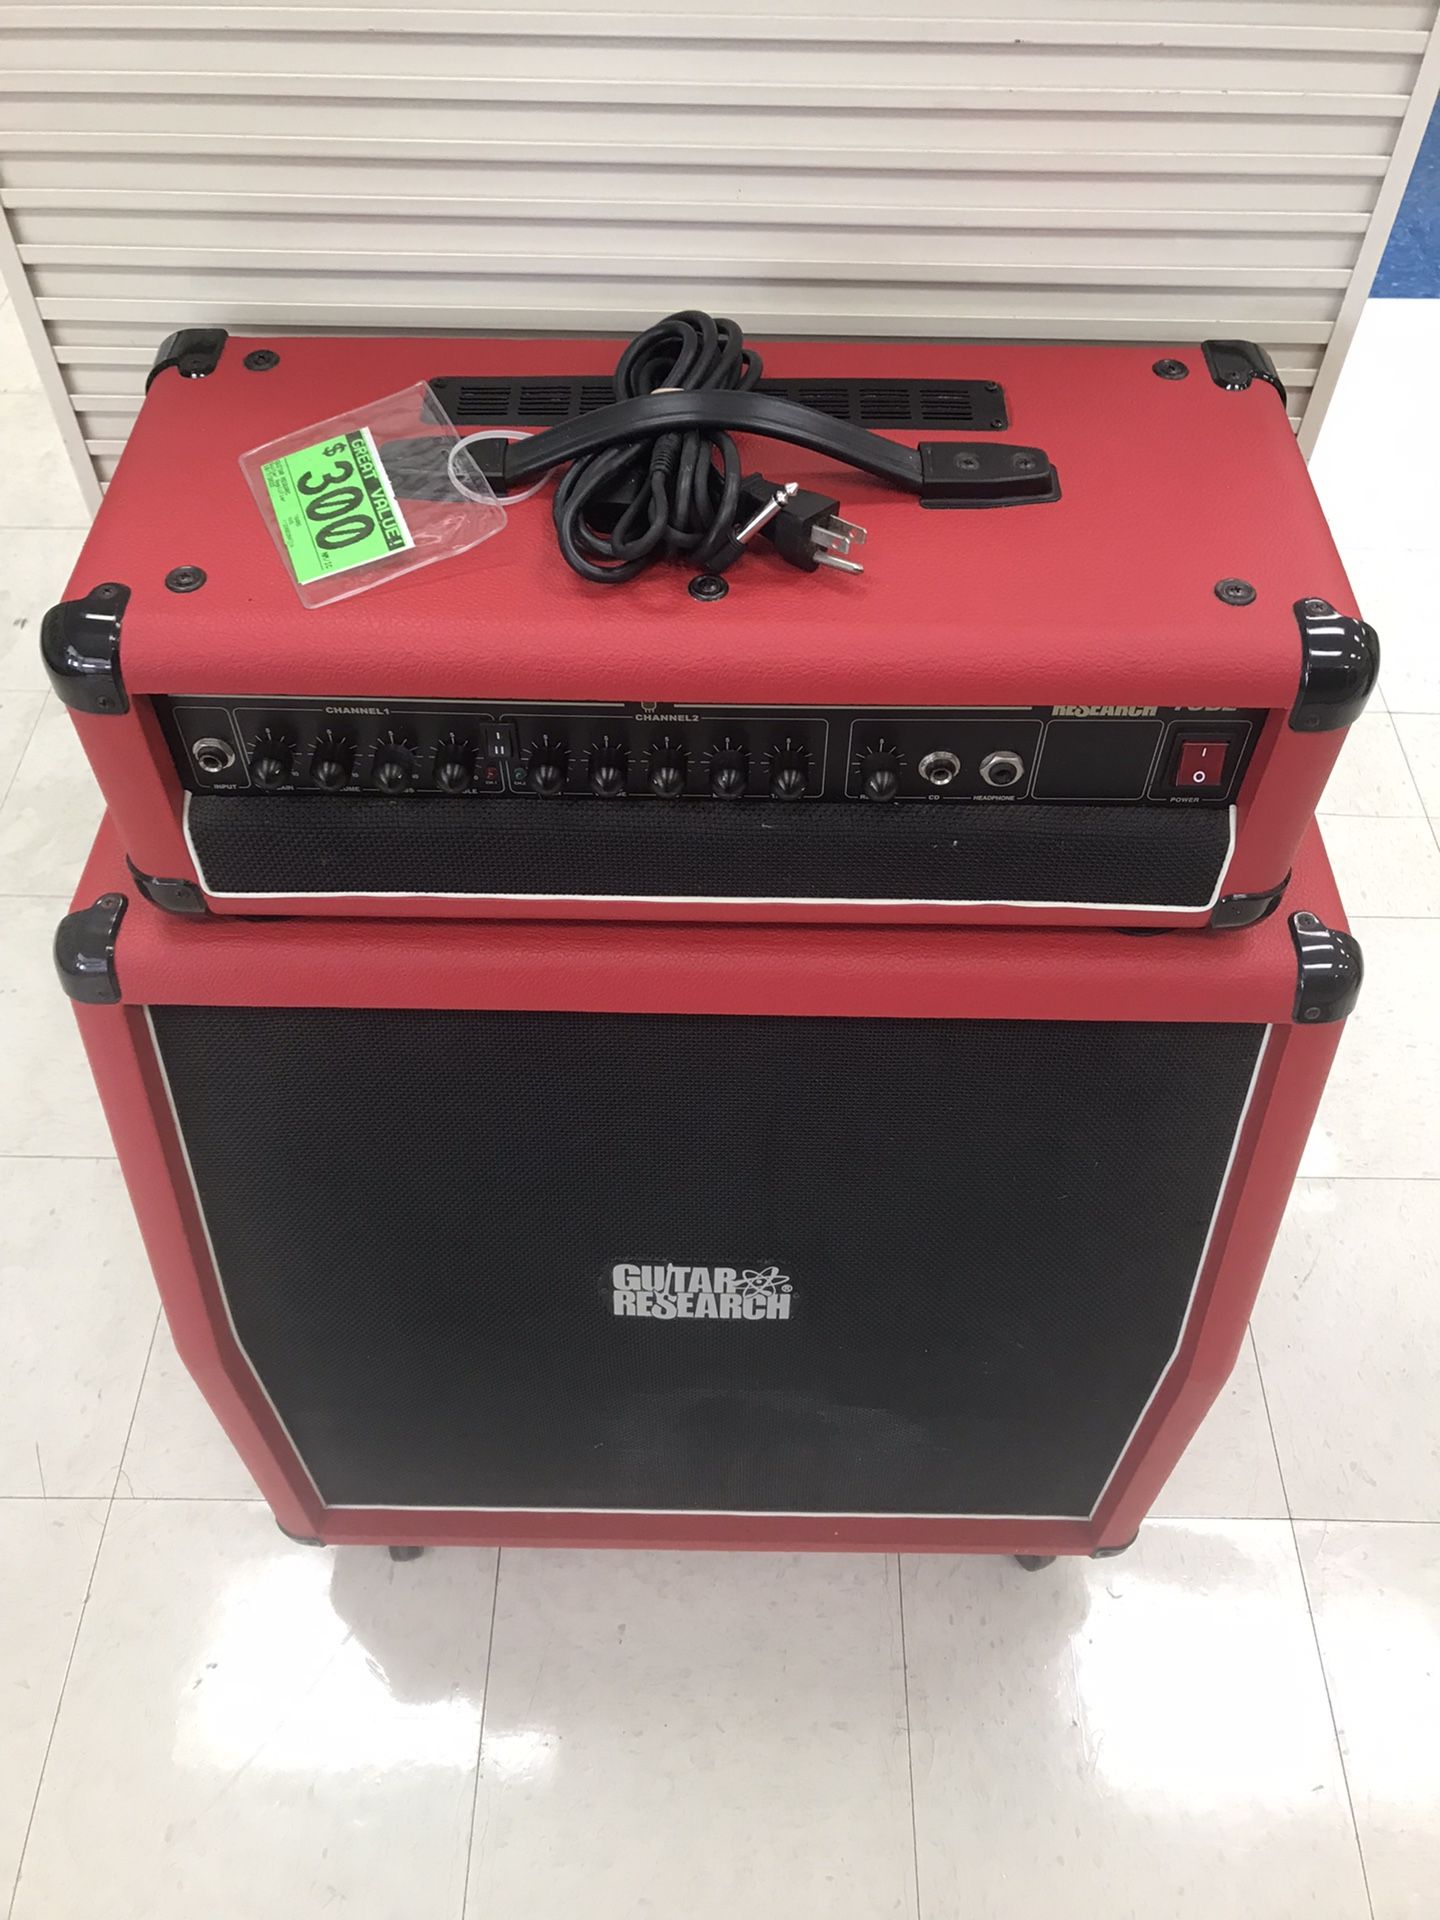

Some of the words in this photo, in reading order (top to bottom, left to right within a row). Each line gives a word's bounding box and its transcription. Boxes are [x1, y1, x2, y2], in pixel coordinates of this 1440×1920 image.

[322, 442, 347, 457] $
[351, 438, 378, 480] GREAT
[369, 487, 405, 547] VALUE!
[297, 460, 375, 550] 300
[325, 706, 390, 716] CHANNEL1
[635, 713, 700, 722] CHANNEL2
[613, 1290, 791, 1320] RESEARCH
